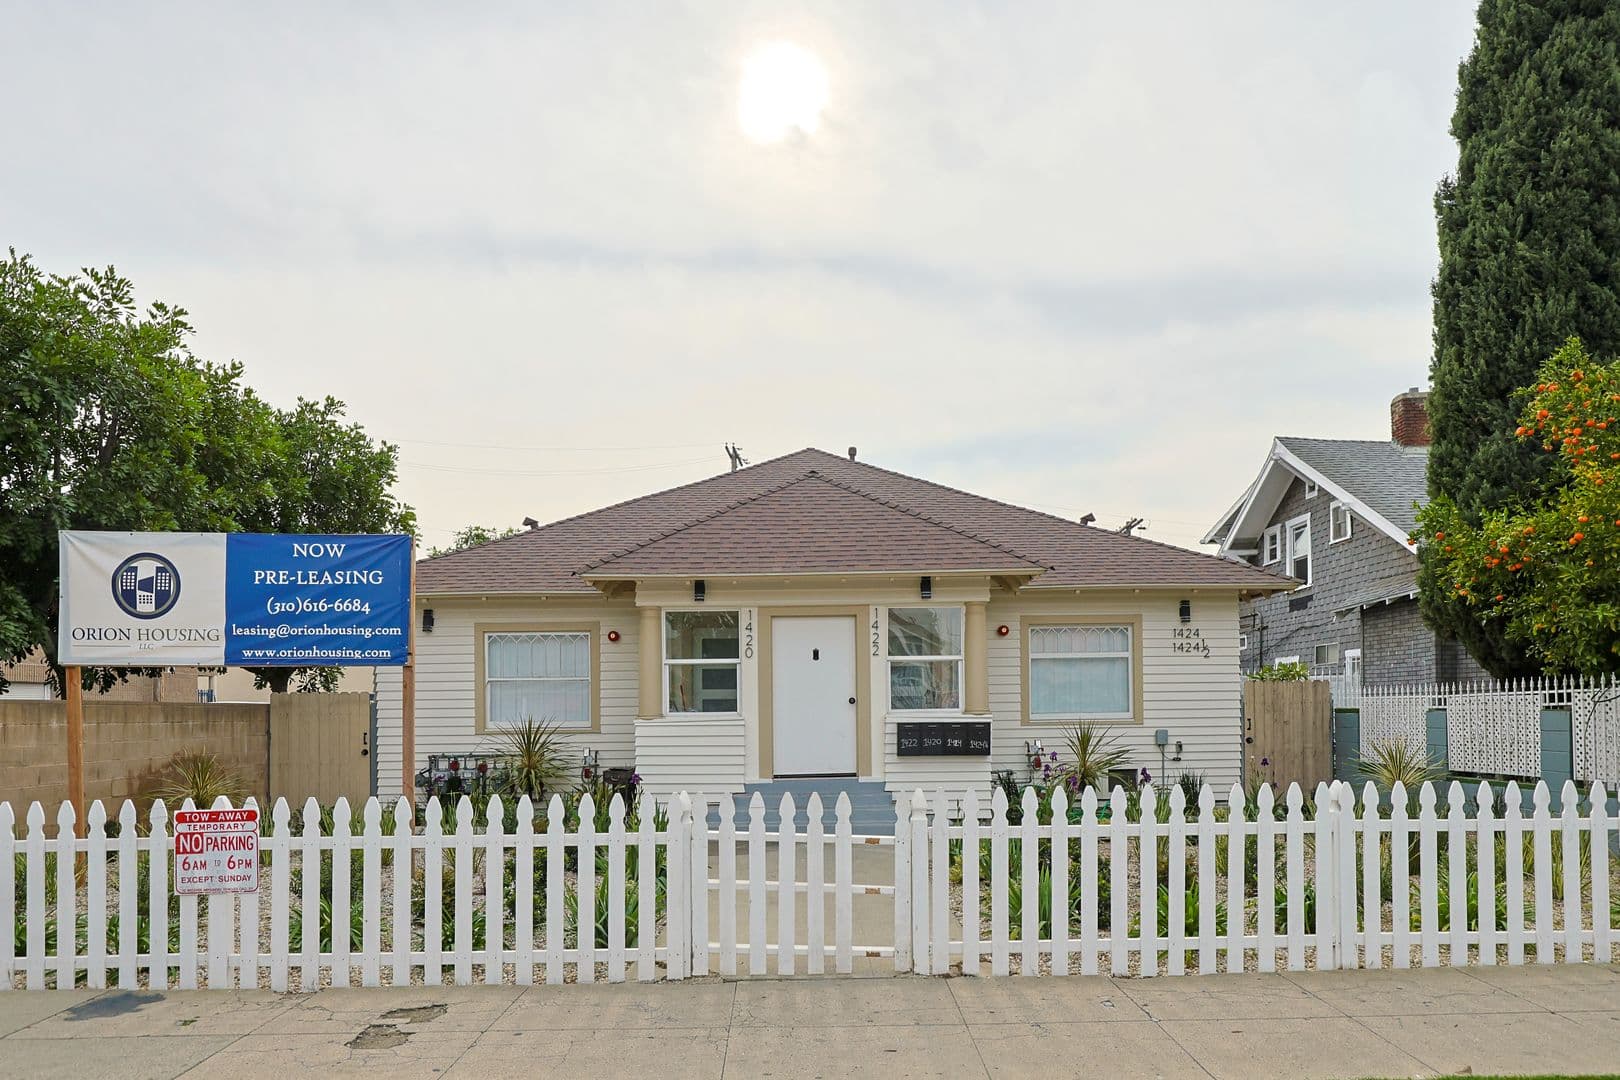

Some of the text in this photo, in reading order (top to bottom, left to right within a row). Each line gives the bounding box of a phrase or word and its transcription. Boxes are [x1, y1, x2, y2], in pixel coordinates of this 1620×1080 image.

[292, 543, 346, 558] NOW
[253, 570, 384, 585] PRE-LEASING
[267, 596, 371, 615] (310)616-6684
[72, 627, 220, 642] ORION HOUSING
[232, 624, 402, 639] leasing@orionhousing.com
[744, 609, 754, 659] 1420
[871, 607, 880, 656] 1422
[1173, 628, 1200, 639] 1424
[242, 646, 391, 660] www.orionhousing.com
[184, 811, 248, 822] TOW-AWAY
[187, 823, 246, 831] TEMPORARY
[180, 834, 254, 853] NO PARKING
[181, 874, 252, 884] EXCEPT SUNDAY
